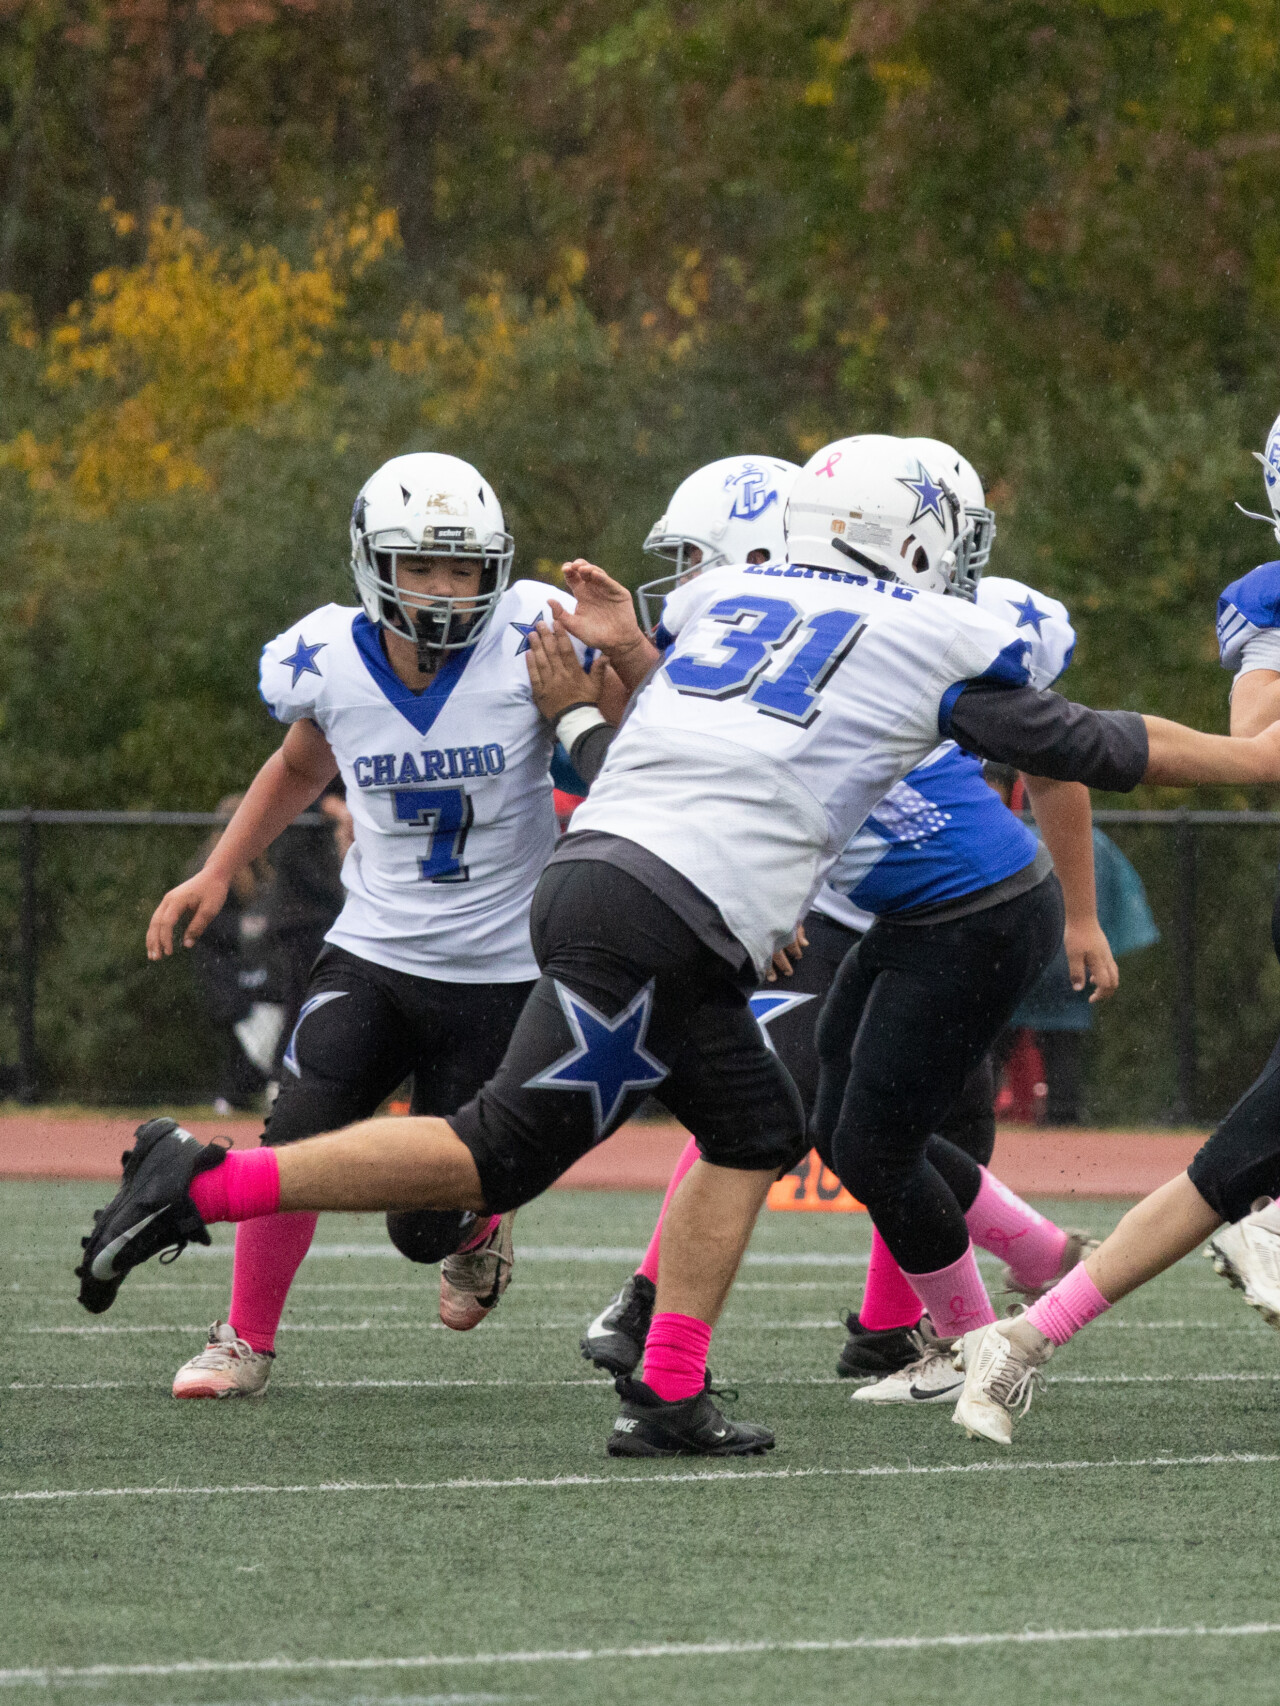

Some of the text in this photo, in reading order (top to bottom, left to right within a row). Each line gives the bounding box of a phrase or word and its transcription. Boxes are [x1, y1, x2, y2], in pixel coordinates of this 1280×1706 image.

[660, 592, 870, 730] 31
[353, 743, 506, 788] CHARIHO
[390, 783, 474, 884] 7
